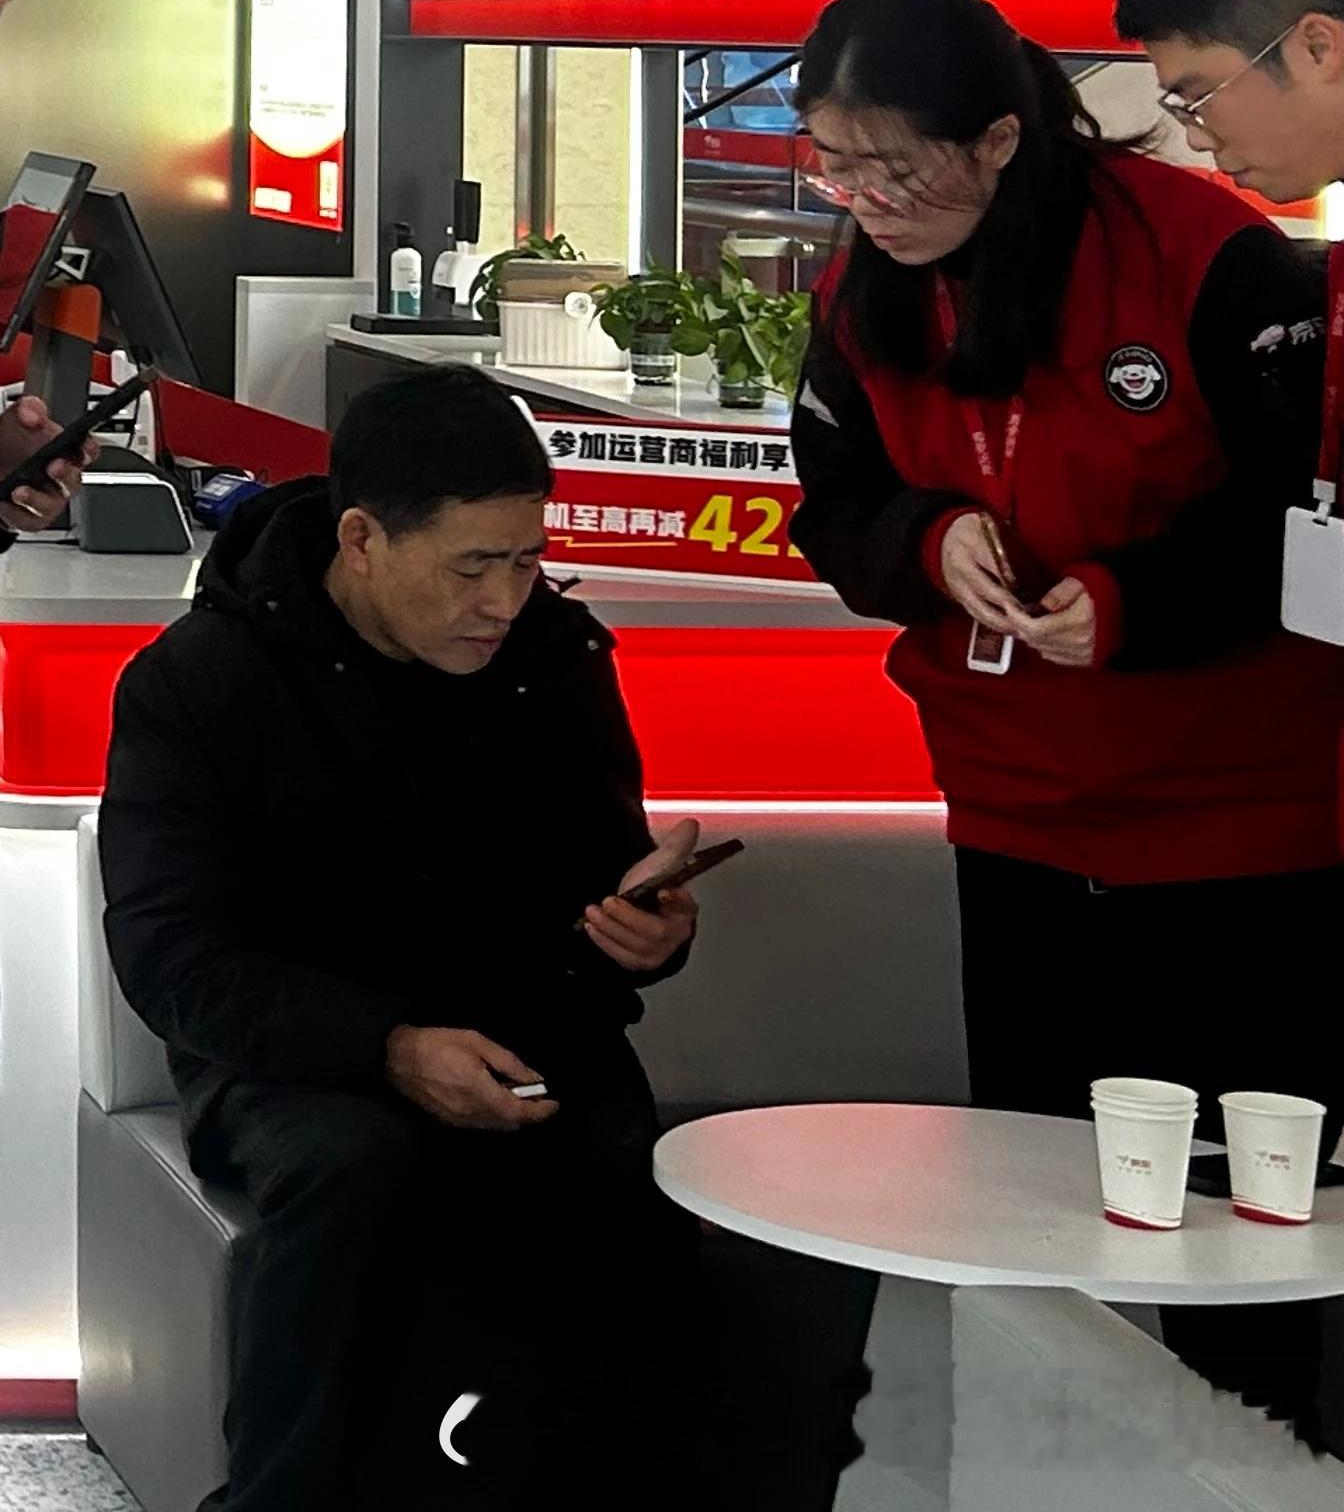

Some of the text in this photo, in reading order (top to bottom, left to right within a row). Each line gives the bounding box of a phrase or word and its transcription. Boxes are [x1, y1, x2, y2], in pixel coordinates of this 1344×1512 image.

[549, 429, 789, 471] 参加运营商福利享
